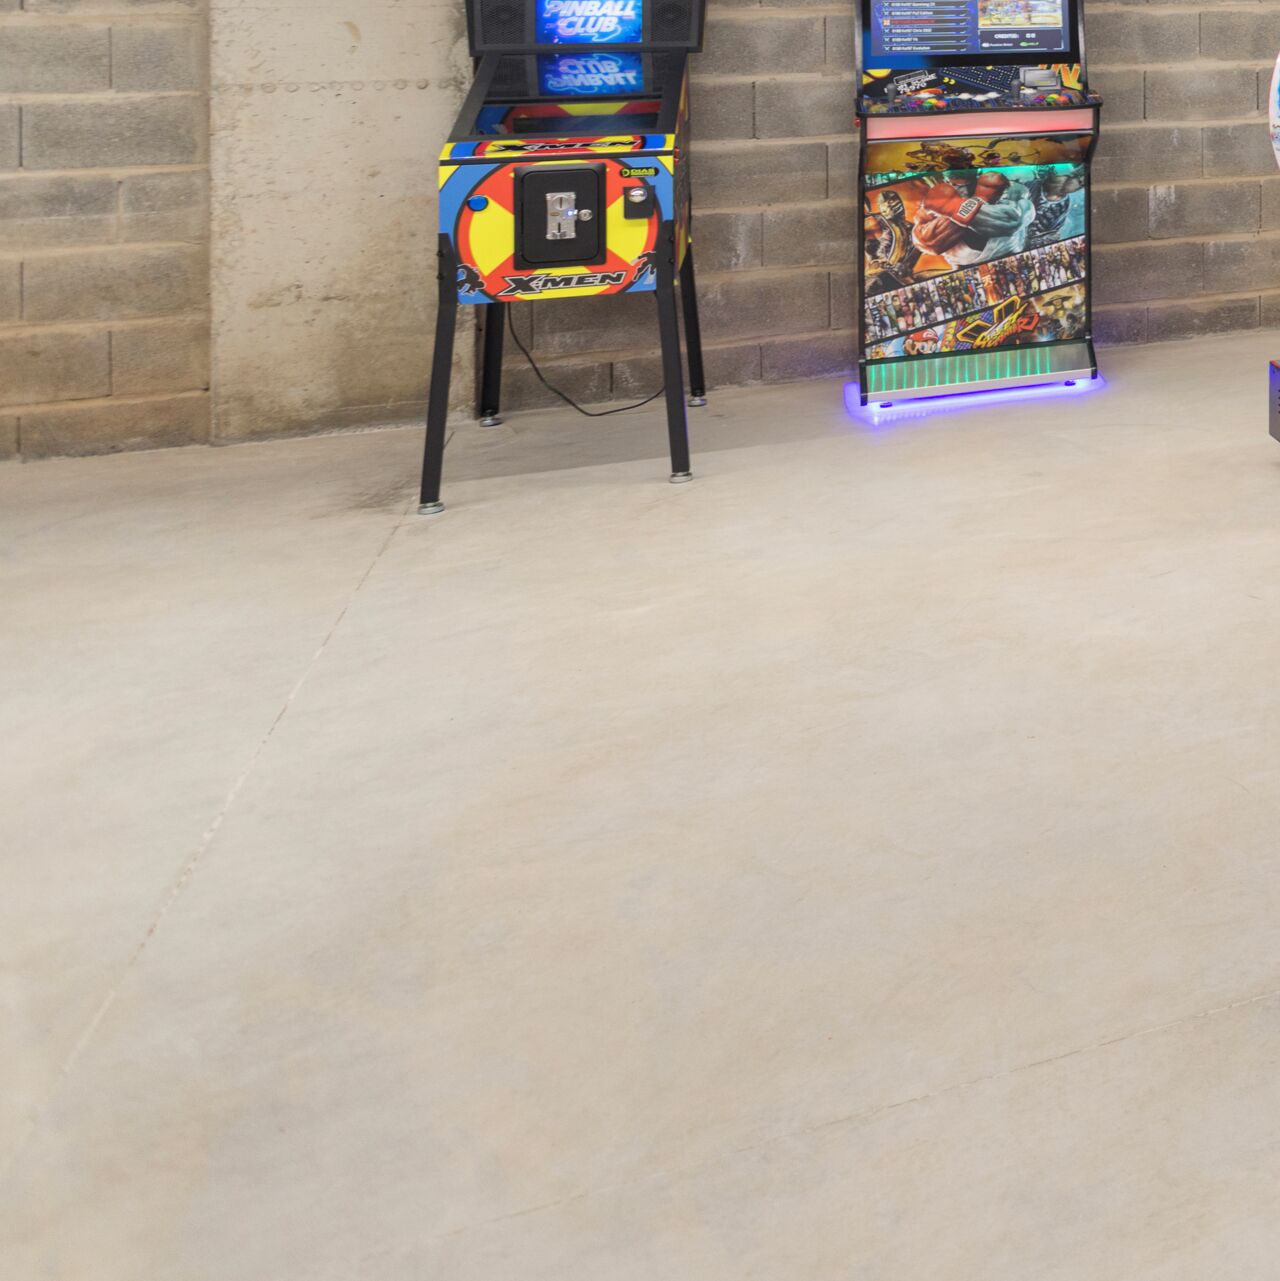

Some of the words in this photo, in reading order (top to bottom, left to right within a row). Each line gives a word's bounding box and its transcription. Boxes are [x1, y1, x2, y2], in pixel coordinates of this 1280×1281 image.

[543, 0, 636, 18] PINBALL
[557, 15, 619, 35] CLUB
[496, 271, 627, 296] X-MEN
